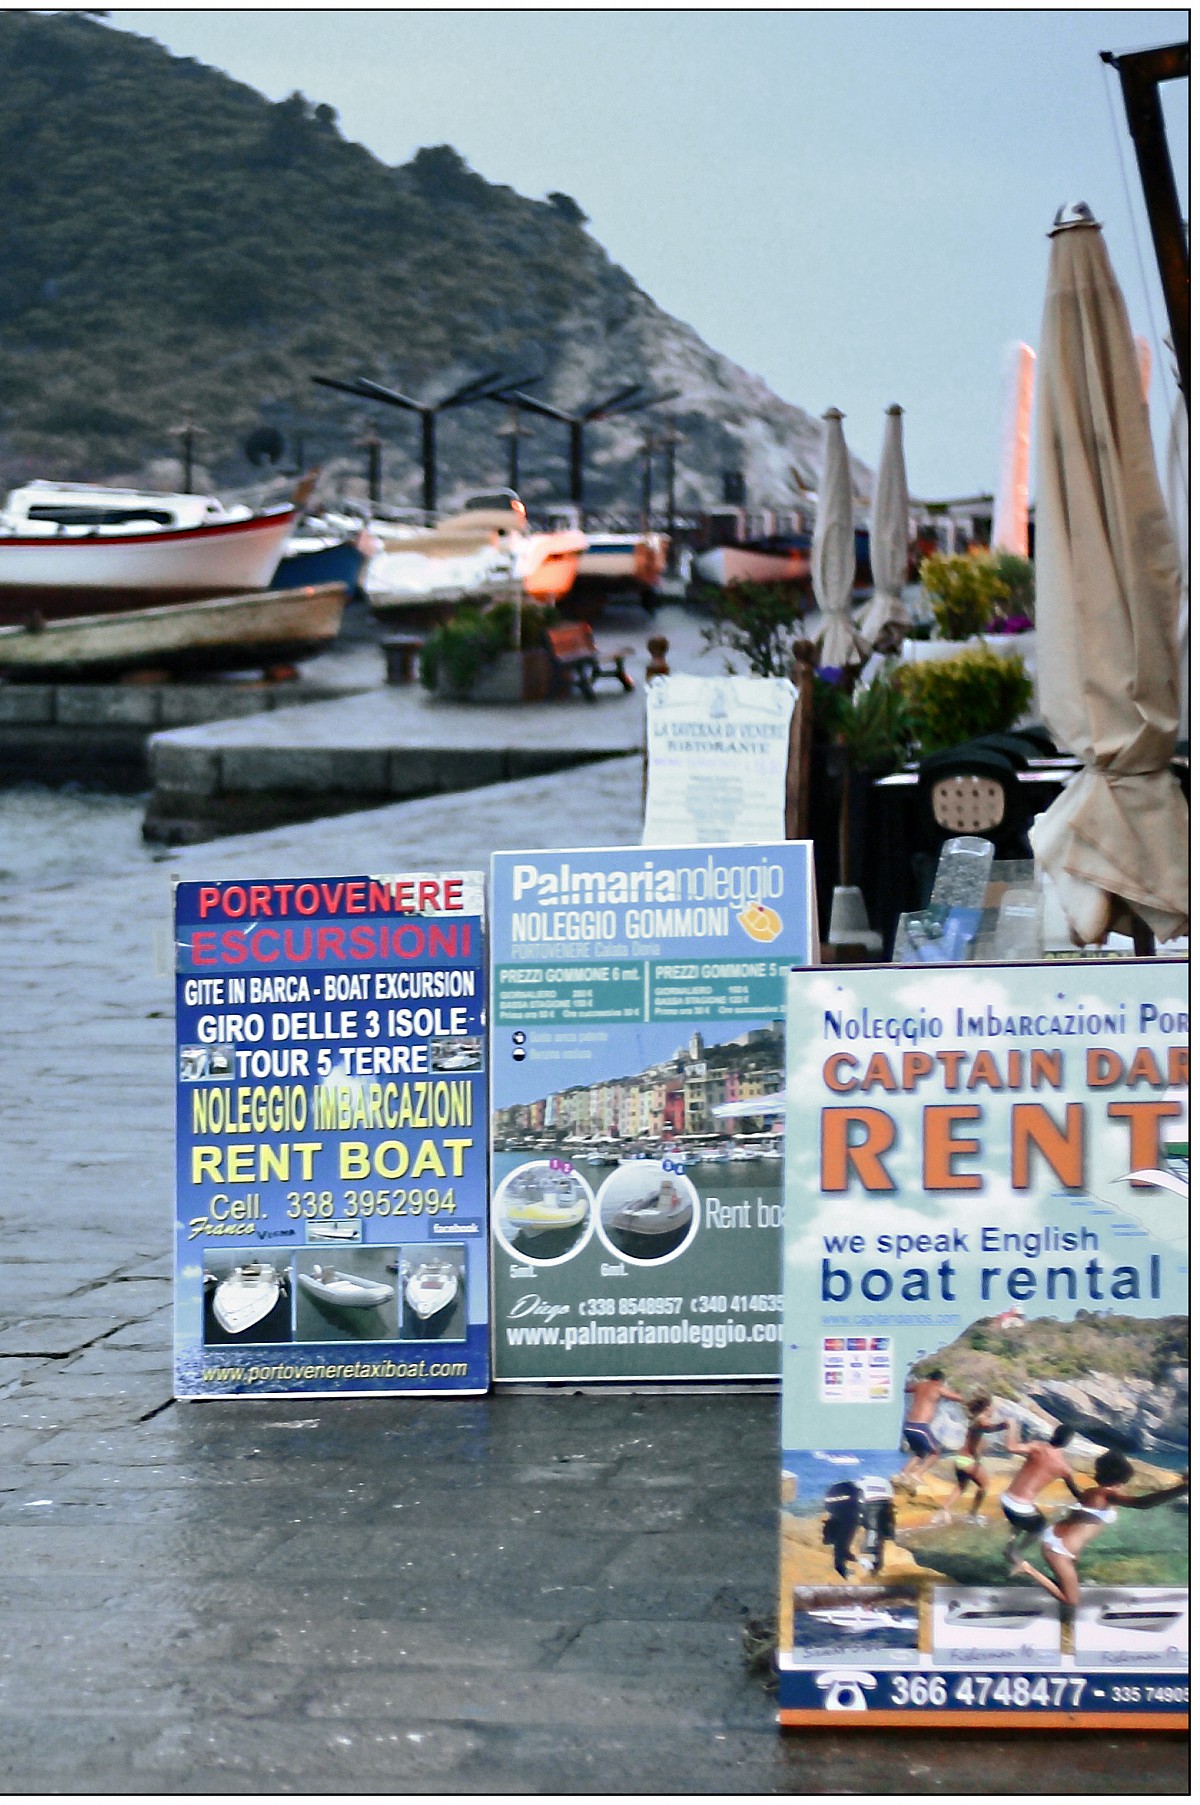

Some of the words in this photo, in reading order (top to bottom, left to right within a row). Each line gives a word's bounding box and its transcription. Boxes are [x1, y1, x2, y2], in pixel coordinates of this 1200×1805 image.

[668, 740, 769, 753] RISTORANTE
[200, 879, 464, 918] PORTOVENERE
[512, 911, 616, 942] NOLEGGIO
[625, 907, 729, 939] GOMMONI
[191, 923, 471, 965] ESCURSIONI
[185, 979, 224, 1006] GITE
[228, 977, 245, 1004] IN
[250, 975, 310, 1003] BARCA
[324, 974, 371, 1001] BOAT
[375, 970, 475, 999] EXCURSION
[500, 969, 543, 983] PREZZI
[545, 967, 610, 982] GOMMONE
[612, 967, 620, 981] 6
[655, 965, 699, 979] PREZZI
[701, 963, 766, 978] GOMMONE
[769, 963, 777, 977] 5
[197, 1013, 264, 1043] GIRO
[272, 1011, 358, 1041] DELLE
[365, 1010, 380, 1038] 3
[388, 1007, 467, 1037] ISOLE
[235, 1048, 309, 1078] TOUR
[317, 1048, 332, 1076] 5
[339, 1046, 428, 1075] TERRE
[822, 1048, 1064, 1091] CAPTAIN
[193, 1085, 307, 1134] NOLEGGIO
[313, 1080, 472, 1130] IMBARCAZIONI
[191, 1142, 322, 1184] RENT
[339, 1138, 473, 1180] BOAT
[820, 1102, 1182, 1191] RENT
[209, 1193, 268, 1221] Cell.
[286, 1191, 334, 1219] 338
[343, 1188, 456, 1218] 3952994
[705, 1197, 751, 1229] Rent
[187, 1217, 255, 1241] Franco
[824, 1234, 865, 1254] we
[877, 1228, 969, 1259] speak
[980, 1226, 1098, 1258] English
[821, 1258, 956, 1302] boat
[981, 1254, 1161, 1301] rental
[202, 1359, 467, 1383] www.portoveneretaxiboat.com
[891, 1675, 947, 1706] 366
[955, 1675, 1088, 1707] 4748477
[1111, 1686, 1141, 1702] 335
